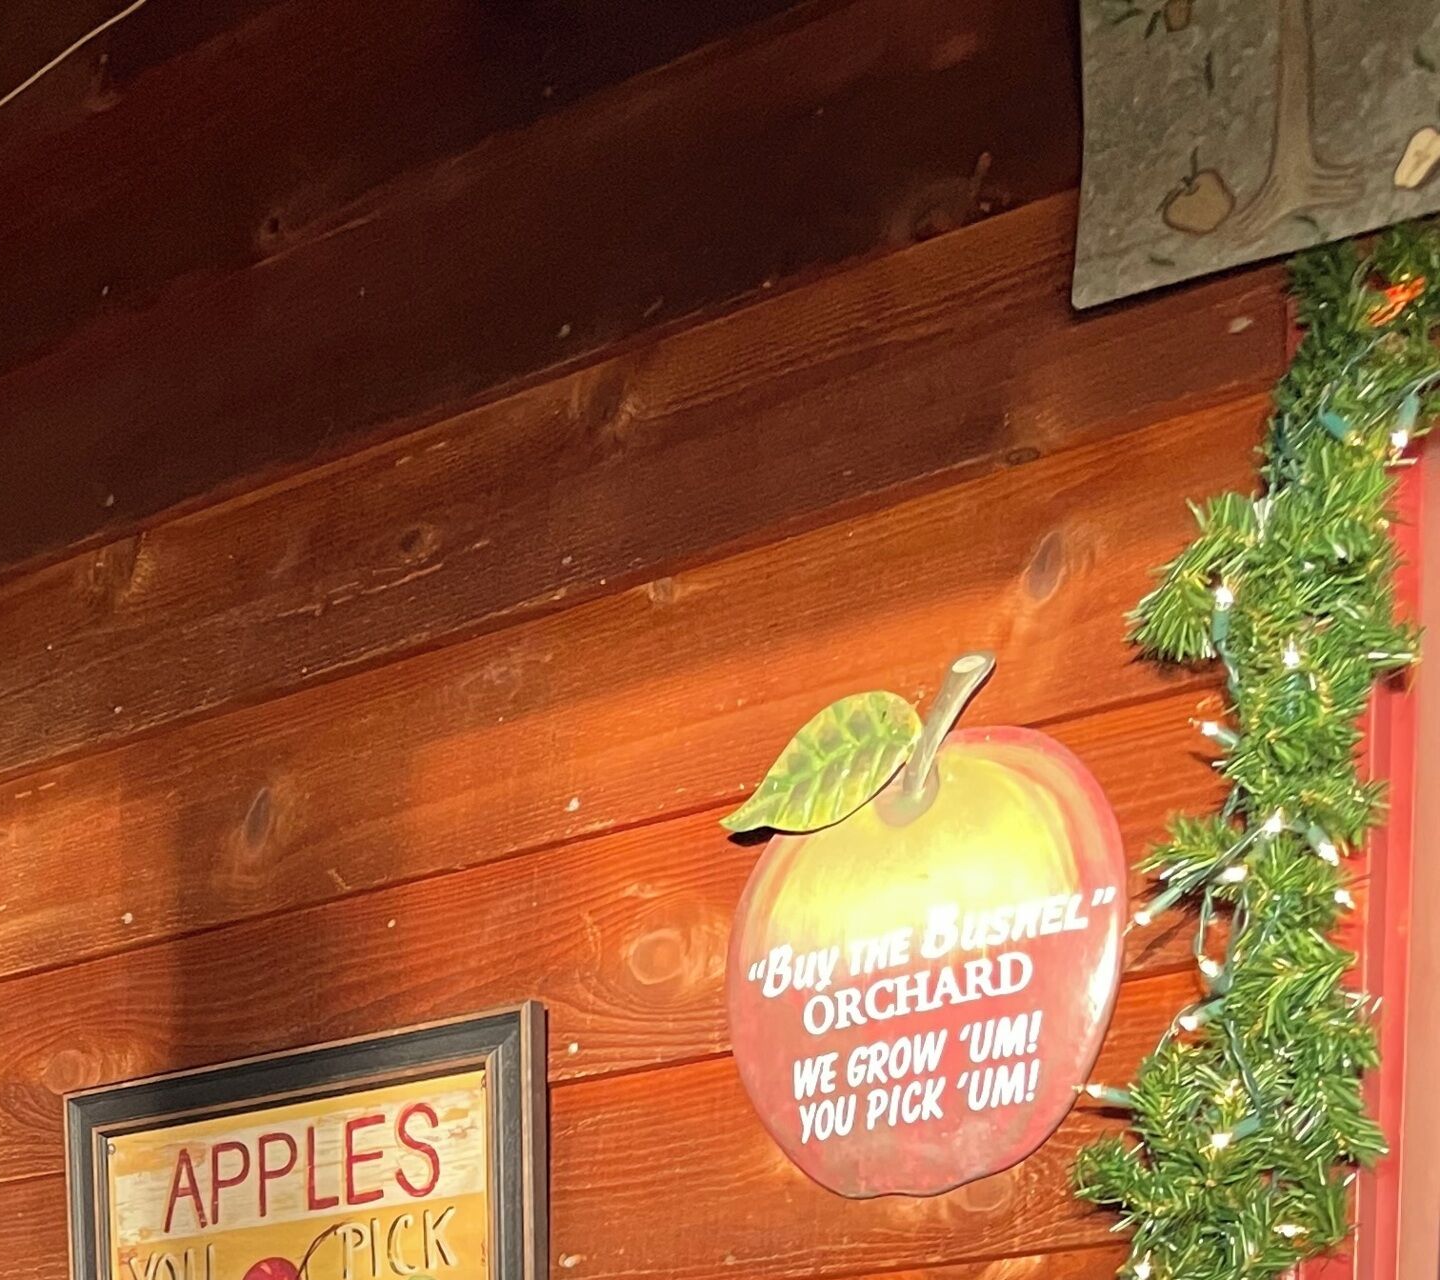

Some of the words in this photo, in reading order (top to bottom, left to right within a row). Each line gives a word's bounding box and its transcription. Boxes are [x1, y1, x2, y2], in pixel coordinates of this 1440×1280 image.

[802, 952, 1034, 1036] ORCHARD
[793, 1051, 838, 1100] WE
[846, 1028, 948, 1086] GROW
[798, 1093, 856, 1144] YOU
[866, 1076, 947, 1130] PICK
[163, 1101, 441, 1233] APPLES
[334, 1206, 457, 1280] PICK
